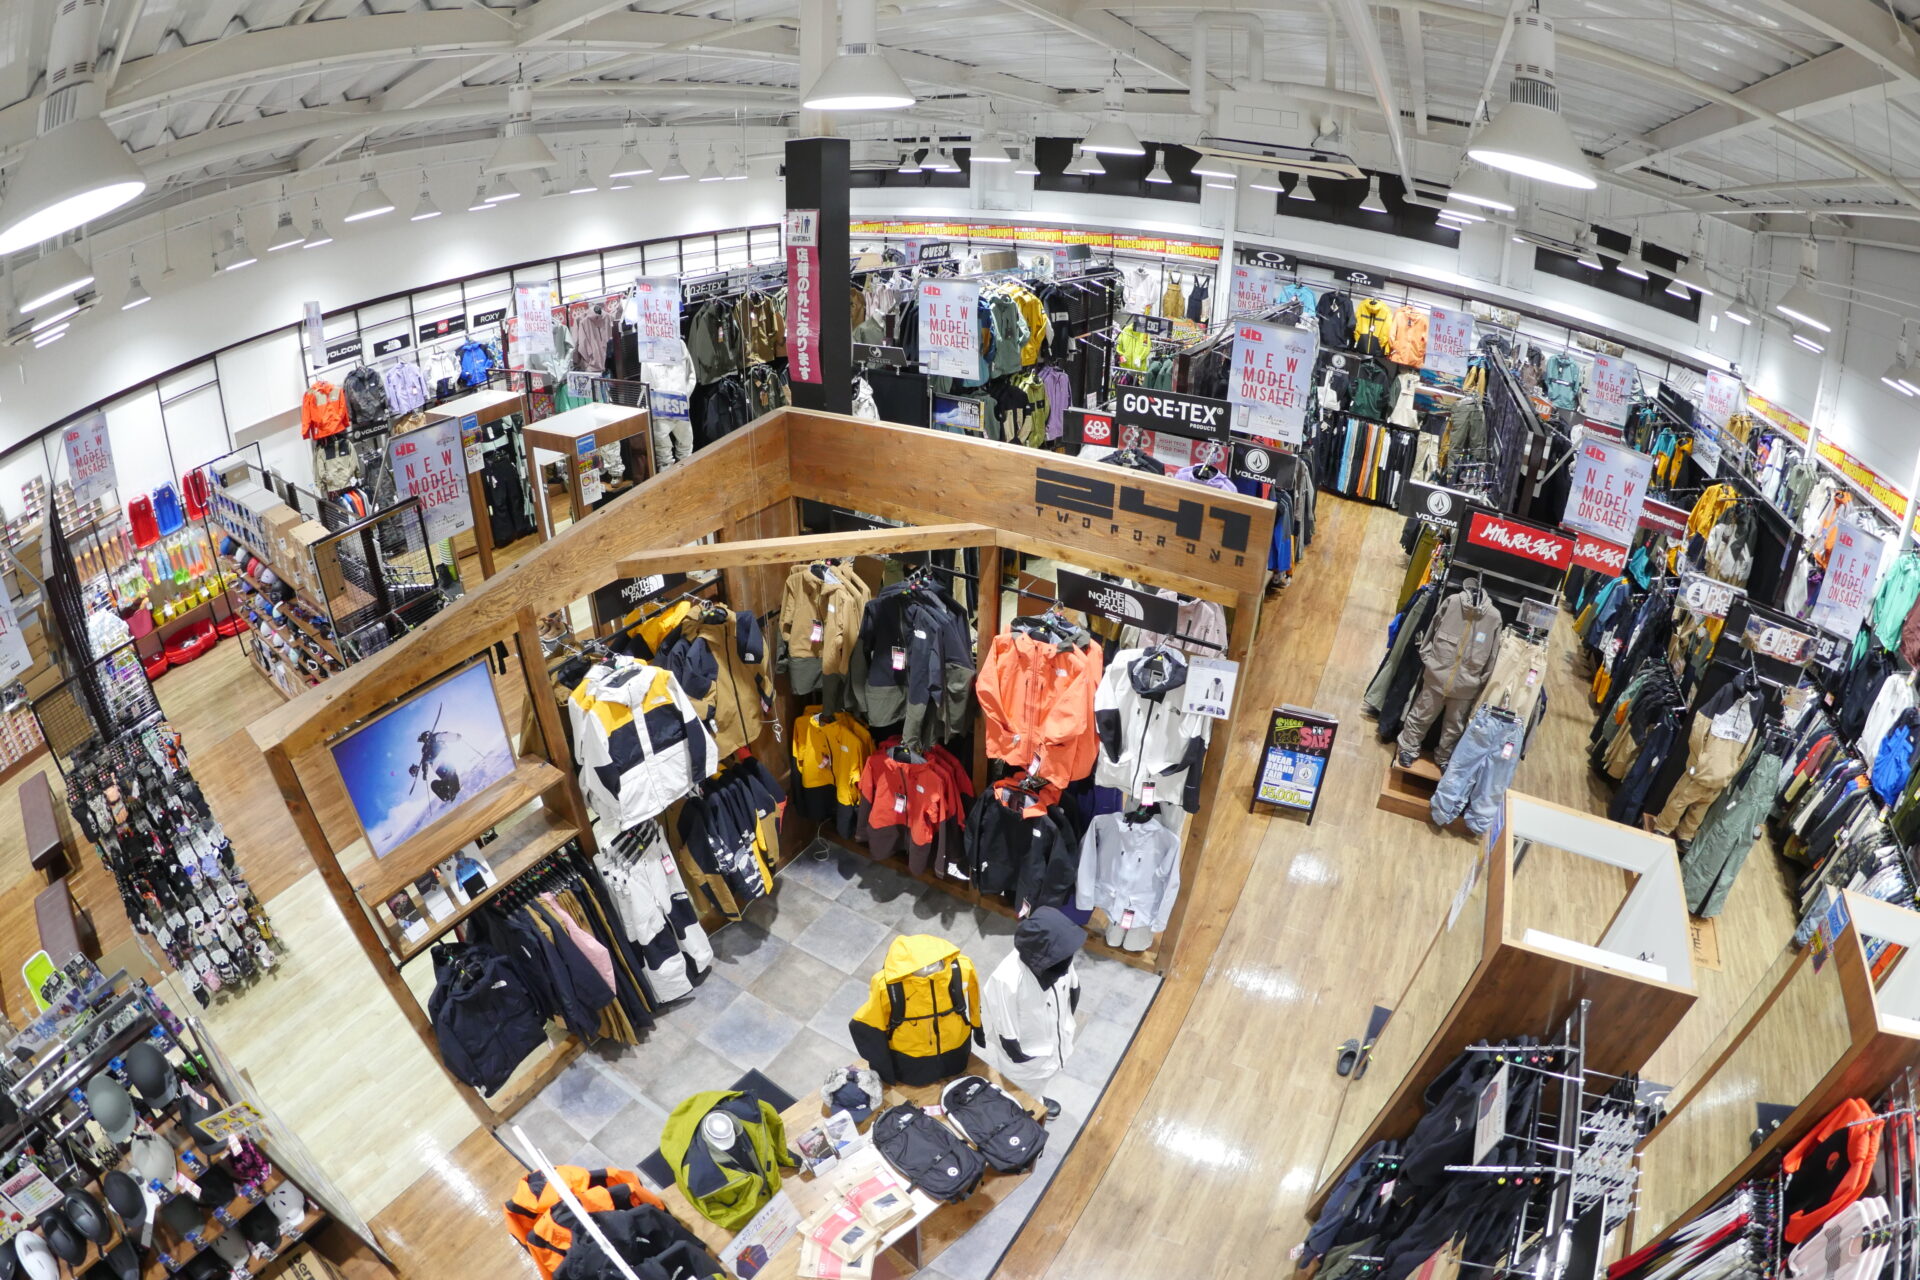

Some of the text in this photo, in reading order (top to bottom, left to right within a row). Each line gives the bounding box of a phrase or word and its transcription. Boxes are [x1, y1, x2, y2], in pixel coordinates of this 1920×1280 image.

[929, 245, 948, 257] VESP
[1250, 259, 1291, 271] OAKLEY
[1239, 281, 1267, 293] NEW
[1347, 276, 1372, 285] OAKLEY
[1238, 291, 1266, 302] MODEL
[643, 299, 672, 312] NEW
[929, 303, 968, 319] NEW
[1248, 301, 1265, 310] SALE
[480, 312, 499, 323] ROXY
[645, 312, 673, 326] MODEL
[796, 248, 811, 380] 店舗の外にあります
[929, 318, 969, 335] MODEL
[1436, 323, 1465, 337] NEW
[1435, 334, 1464, 347] MODEL
[1245, 349, 1298, 374] NEW
[1243, 366, 1295, 392] MODEL
[361, 424, 388, 435] VOLCOM
[1084, 420, 1110, 438] 686
[1189, 423, 1217, 432] PRODUCTS
[73, 435, 102, 457] NEW
[1121, 428, 1151, 450] 66
[76, 447, 105, 468] MODEL
[405, 449, 452, 480] NEW
[408, 468, 456, 497] MODEL
[1234, 469, 1276, 485] VOLCOM
[1586, 467, 1635, 497] NEW
[1582, 485, 1628, 515] MODEL
[1416, 511, 1457, 527] VOLCOM
[1837, 553, 1870, 578] NEW
[621, 576, 649, 598] NORTH
[1832, 570, 1865, 594] MODEL
[631, 585, 651, 602] FACE
[1088, 590, 1125, 608] NORTH
[1104, 588, 1125, 600] THE
[1098, 600, 1125, 615] FACE
[1776, 644, 1797, 660] URE
[1300, 727, 1332, 749] SALE
[1268, 753, 1292, 765] WEAR
[1264, 769, 1283, 780] FAIR
[1266, 761, 1294, 774] BRAND
